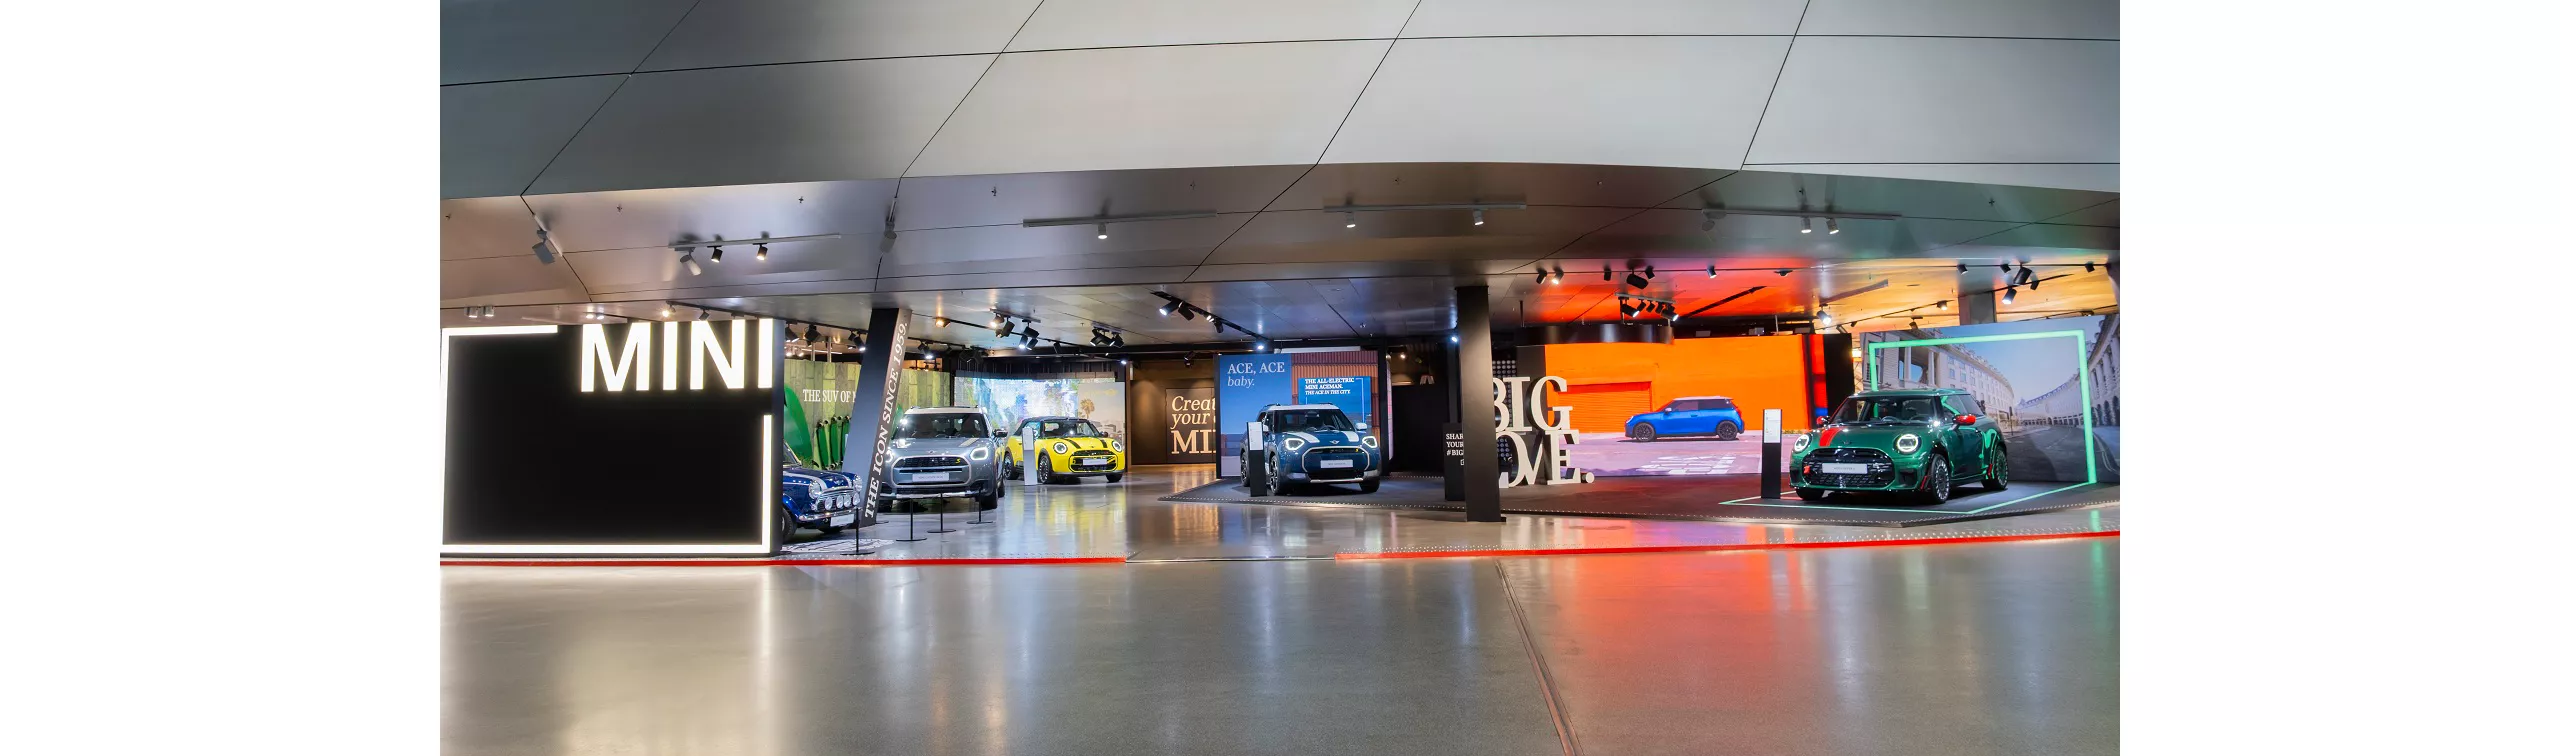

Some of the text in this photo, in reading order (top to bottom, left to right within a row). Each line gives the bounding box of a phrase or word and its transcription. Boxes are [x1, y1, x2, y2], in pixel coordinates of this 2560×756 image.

[581, 318, 773, 392] MINI
[1227, 361, 1285, 375] ACE, ACE
[1227, 375, 1255, 388] baby.
[802, 389, 821, 402] THE
[822, 390, 839, 402] SUV
[840, 390, 851, 402] OF
[1493, 375, 1573, 433] BIG
[864, 322, 908, 518] THE ICON SINCE 1959.
[1170, 413, 1210, 430] your
